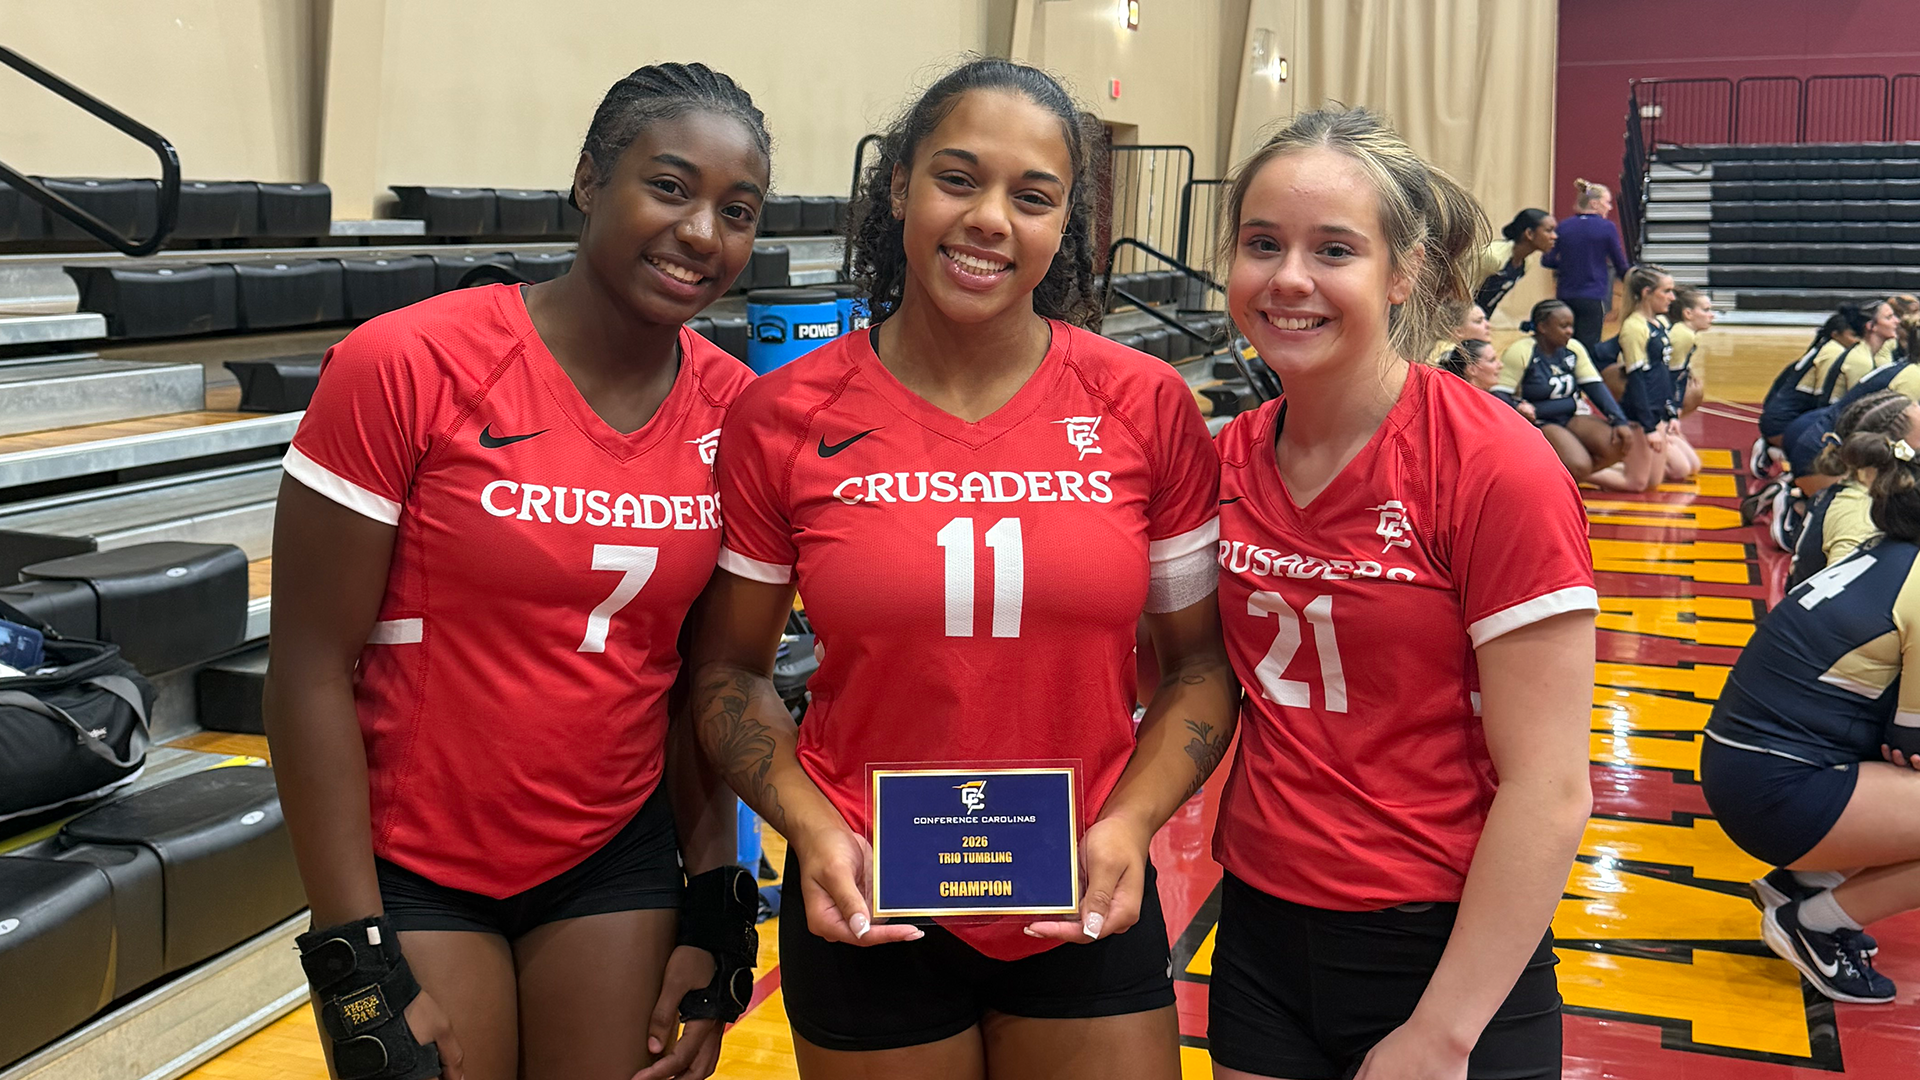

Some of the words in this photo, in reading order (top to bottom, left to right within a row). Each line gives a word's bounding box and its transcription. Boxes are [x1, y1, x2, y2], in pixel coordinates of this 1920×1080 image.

[832, 470, 1114, 505] CRUSADERS
[937, 516, 1025, 639] 11
[576, 543, 660, 654] 7
[1246, 588, 1349, 714] 21
[913, 816, 979, 825] CONFERENCE
[981, 814, 1036, 824] CAROLINAS
[961, 836, 988, 848] 2026
[938, 852, 961, 864] TRIO
[963, 852, 1012, 864] TUMBLING
[939, 880, 1012, 897] CHAMPION
